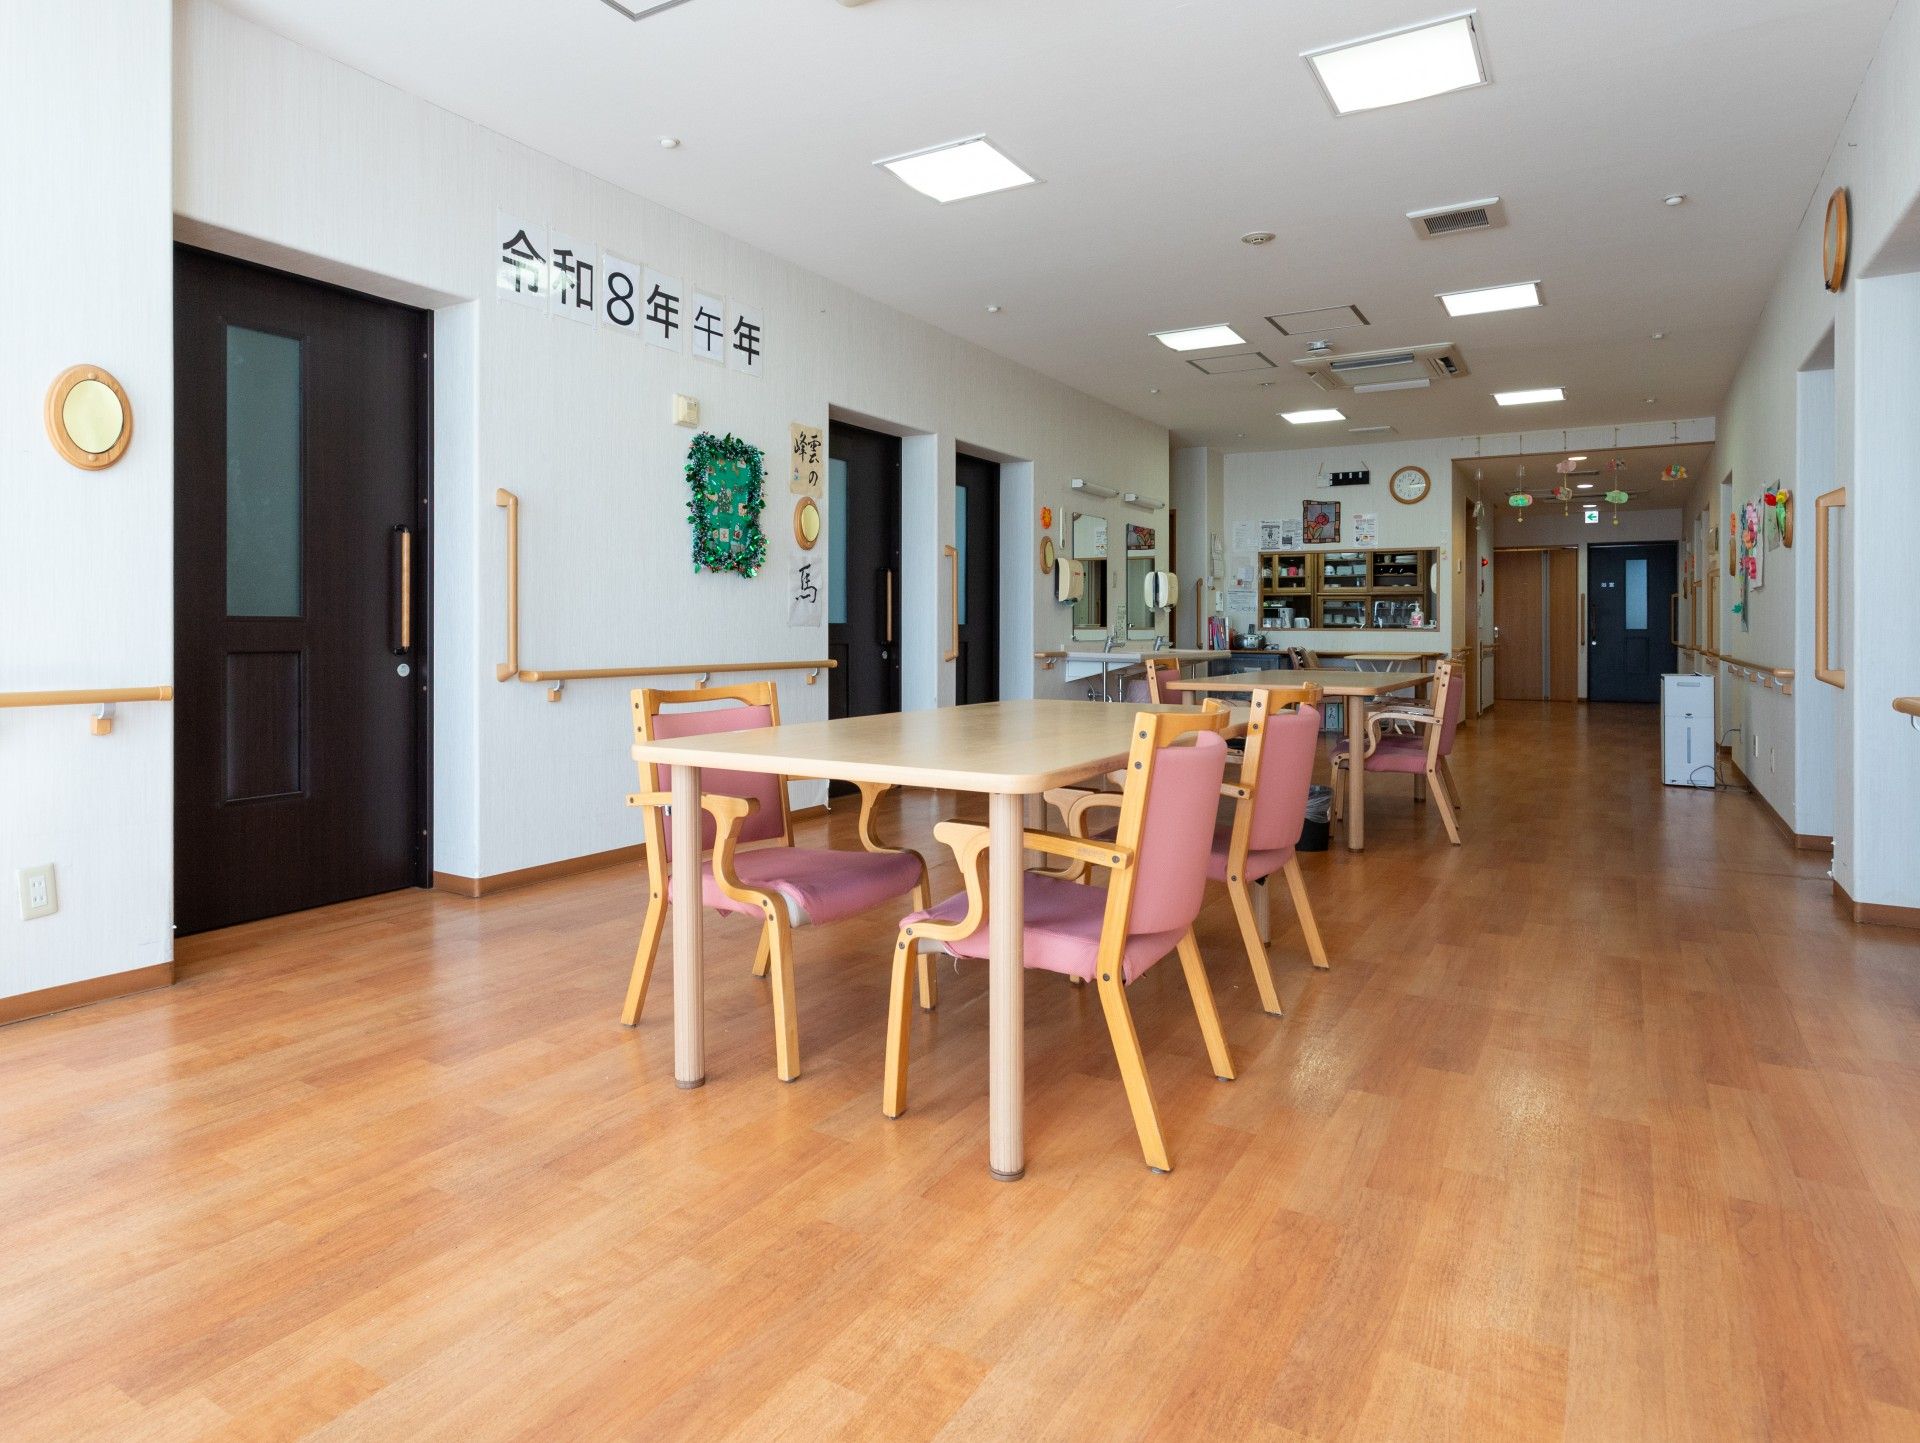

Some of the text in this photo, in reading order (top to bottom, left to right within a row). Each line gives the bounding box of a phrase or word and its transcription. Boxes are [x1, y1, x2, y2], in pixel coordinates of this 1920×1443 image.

[502, 229, 761, 366] 令和8年午年
[794, 563, 819, 604] 馬
